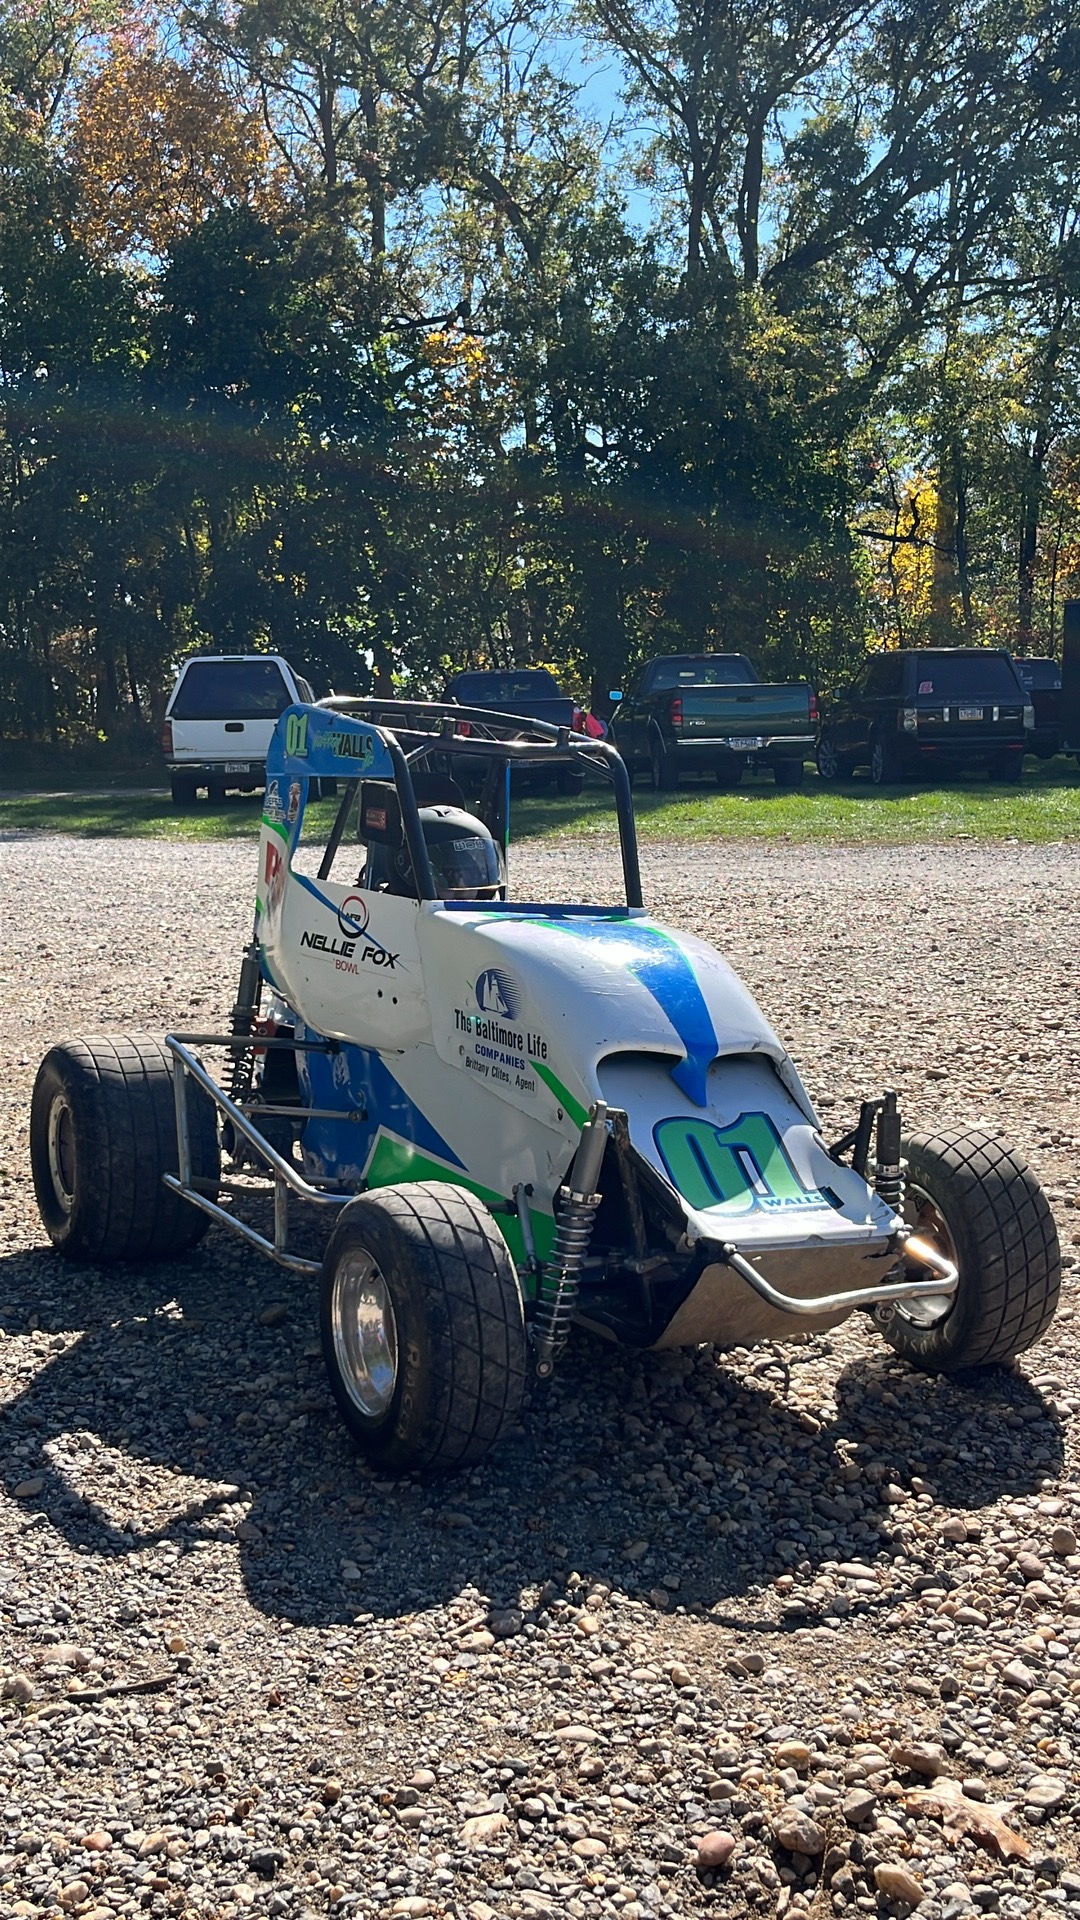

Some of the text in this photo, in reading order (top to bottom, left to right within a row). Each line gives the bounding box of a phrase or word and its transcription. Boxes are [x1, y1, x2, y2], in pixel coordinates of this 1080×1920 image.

[286, 714, 308, 757] 01
[332, 731, 373, 760] WALLS
[300, 931, 400, 969] NELLIE FOX
[335, 959, 360, 975] BOWL
[454, 1009, 547, 1059] The Baltimore Life
[465, 1056, 489, 1077] Brittany
[515, 1075, 535, 1092] Agent
[475, 1043, 525, 1070] COMPANIES
[652, 1111, 808, 1216] 01
[763, 1195, 825, 1207] WALLS
